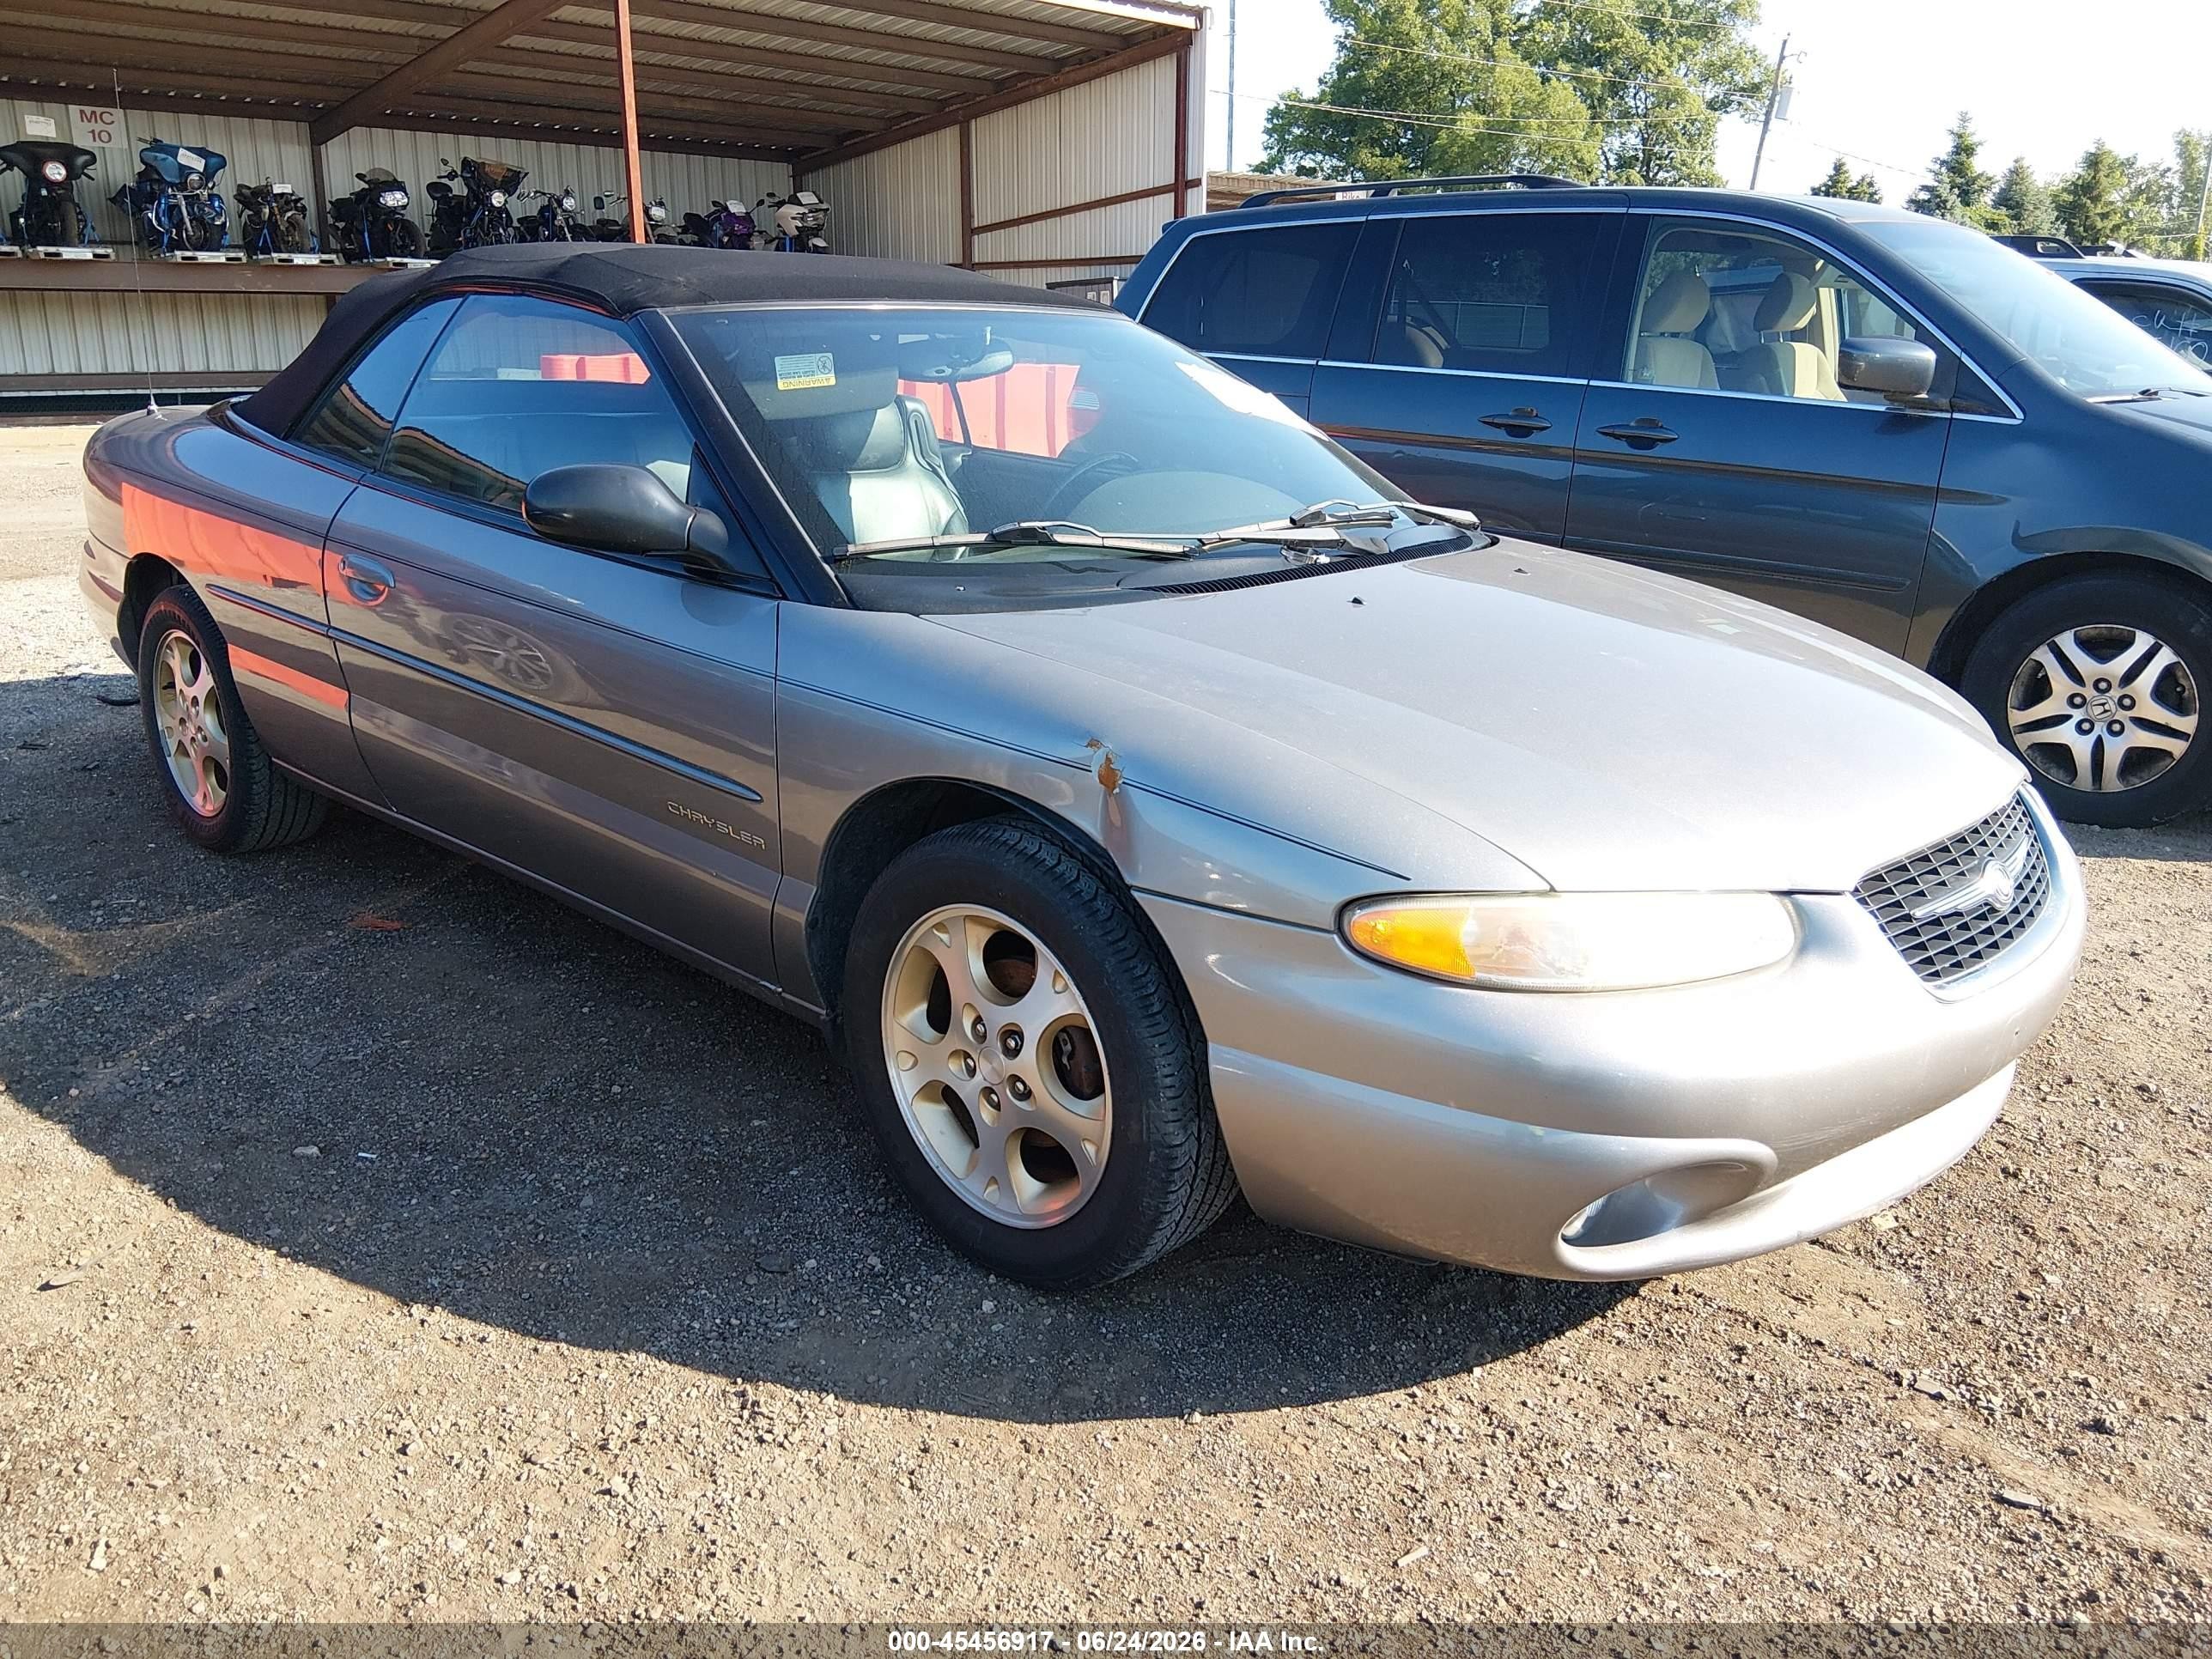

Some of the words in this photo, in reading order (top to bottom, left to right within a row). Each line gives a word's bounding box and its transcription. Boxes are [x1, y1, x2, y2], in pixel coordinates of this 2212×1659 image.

[79, 109, 115, 125] MC
[87, 129, 112, 143] 10
[782, 378, 826, 389] WARNING
[666, 800, 766, 850] CHRYSLER
